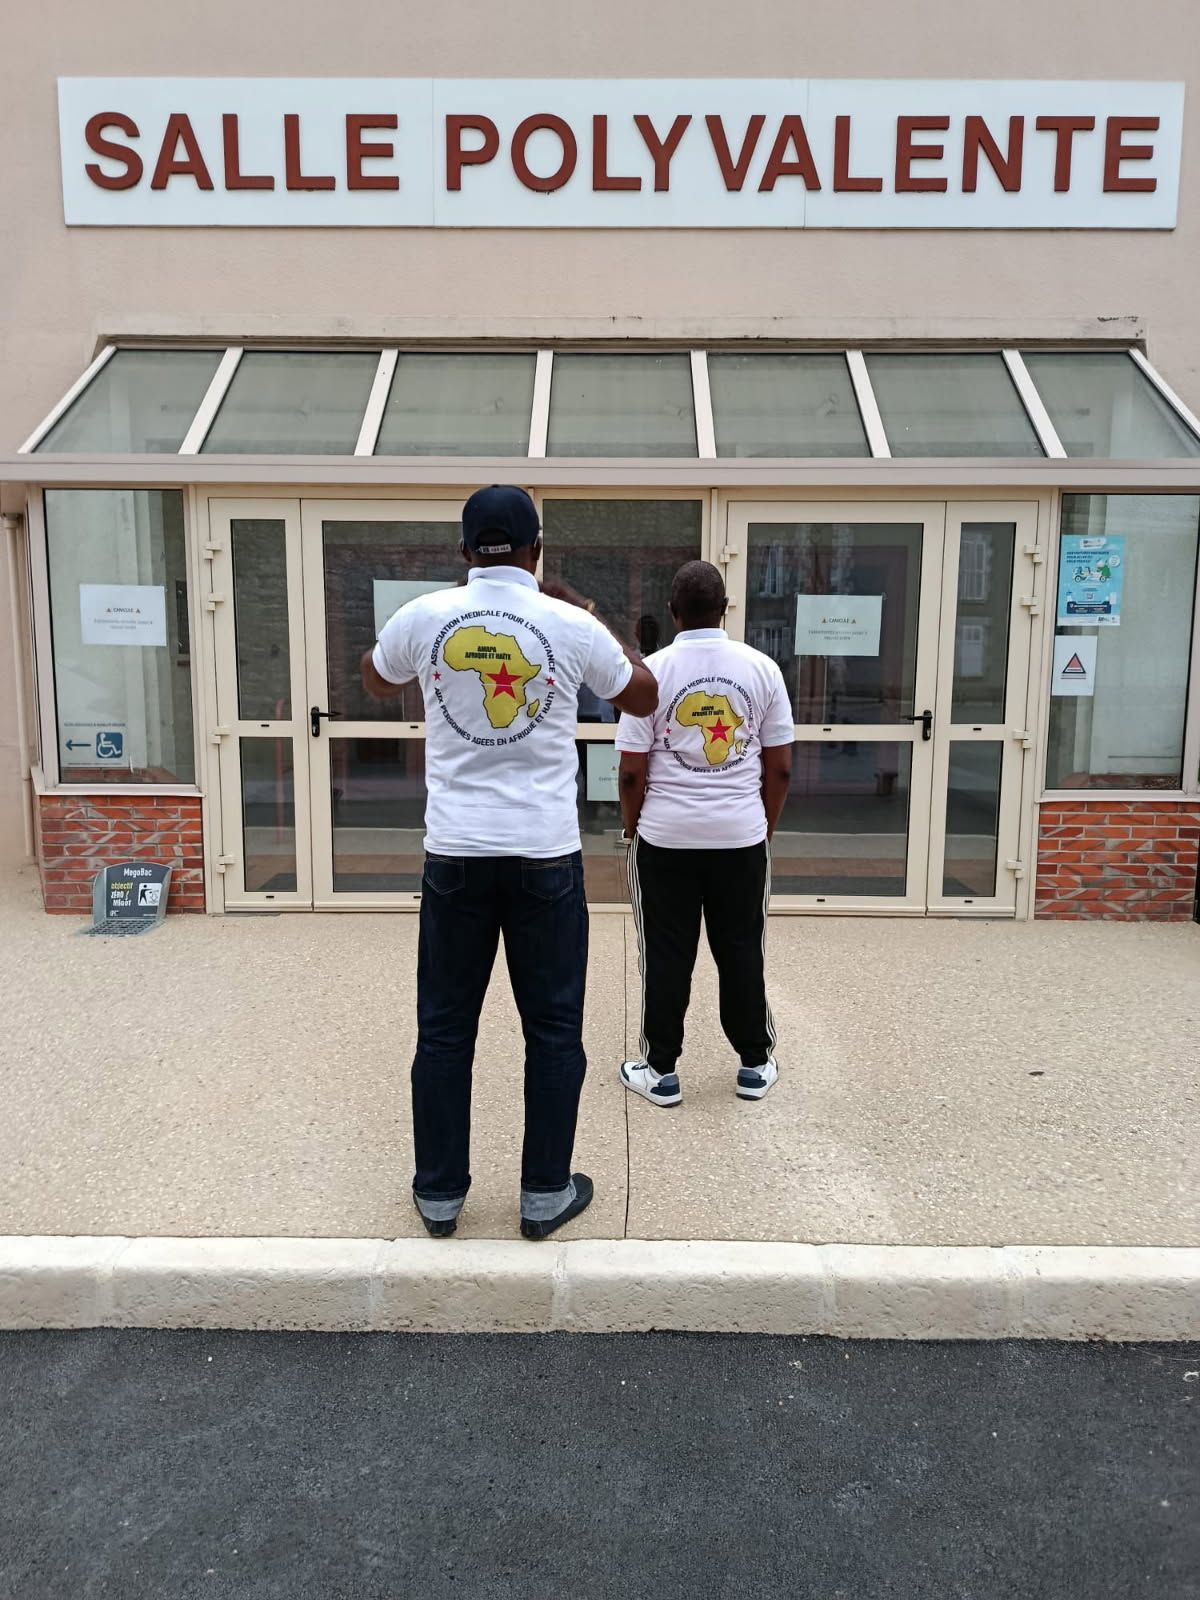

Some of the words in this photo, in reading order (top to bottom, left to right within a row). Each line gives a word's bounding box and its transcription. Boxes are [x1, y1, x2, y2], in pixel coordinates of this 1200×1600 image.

[85, 112, 399, 190] SALLE
[446, 114, 1160, 192] POLYVALENTE
[430, 618, 460, 666] ASSOCIATION
[461, 610, 501, 622] MEDICALE
[502, 611, 525, 626] POUR
[524, 622, 556, 673] L'ASSISTANCE
[464, 651, 488, 659] AFRIQUE
[687, 676, 716, 688] MEDICALE
[716, 676, 734, 686] POUR
[434, 687, 444, 703] AUX
[440, 704, 472, 741] PERSONNES
[496, 737, 508, 747] EN
[509, 721, 537, 744] AFRIQUE
[535, 713, 544, 723] ET
[123, 868, 152, 878] MegoBac
